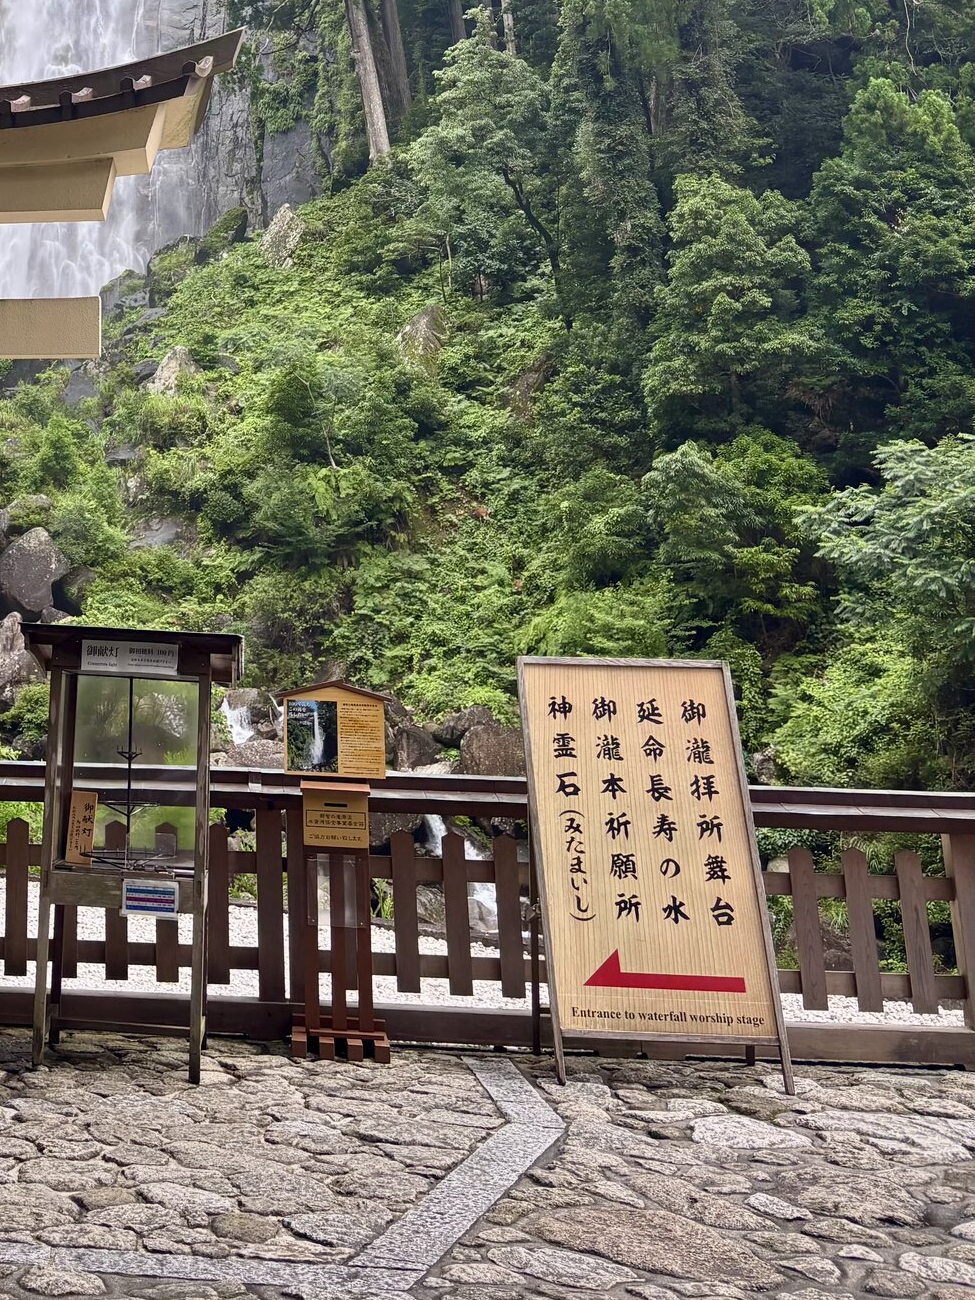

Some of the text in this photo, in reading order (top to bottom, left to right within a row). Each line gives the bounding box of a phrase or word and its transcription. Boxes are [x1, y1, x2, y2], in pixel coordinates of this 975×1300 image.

[86, 645, 120, 658] 御献灯
[81, 802, 95, 837] 御献灯
[591, 696, 642, 923] 御瀧本祈願所
[636, 698, 691, 925] 延命長寿の水
[680, 699, 735, 927] 御瀧拝所舞台
[571, 1006, 765, 1027] Entrance to waterfall worship stage
